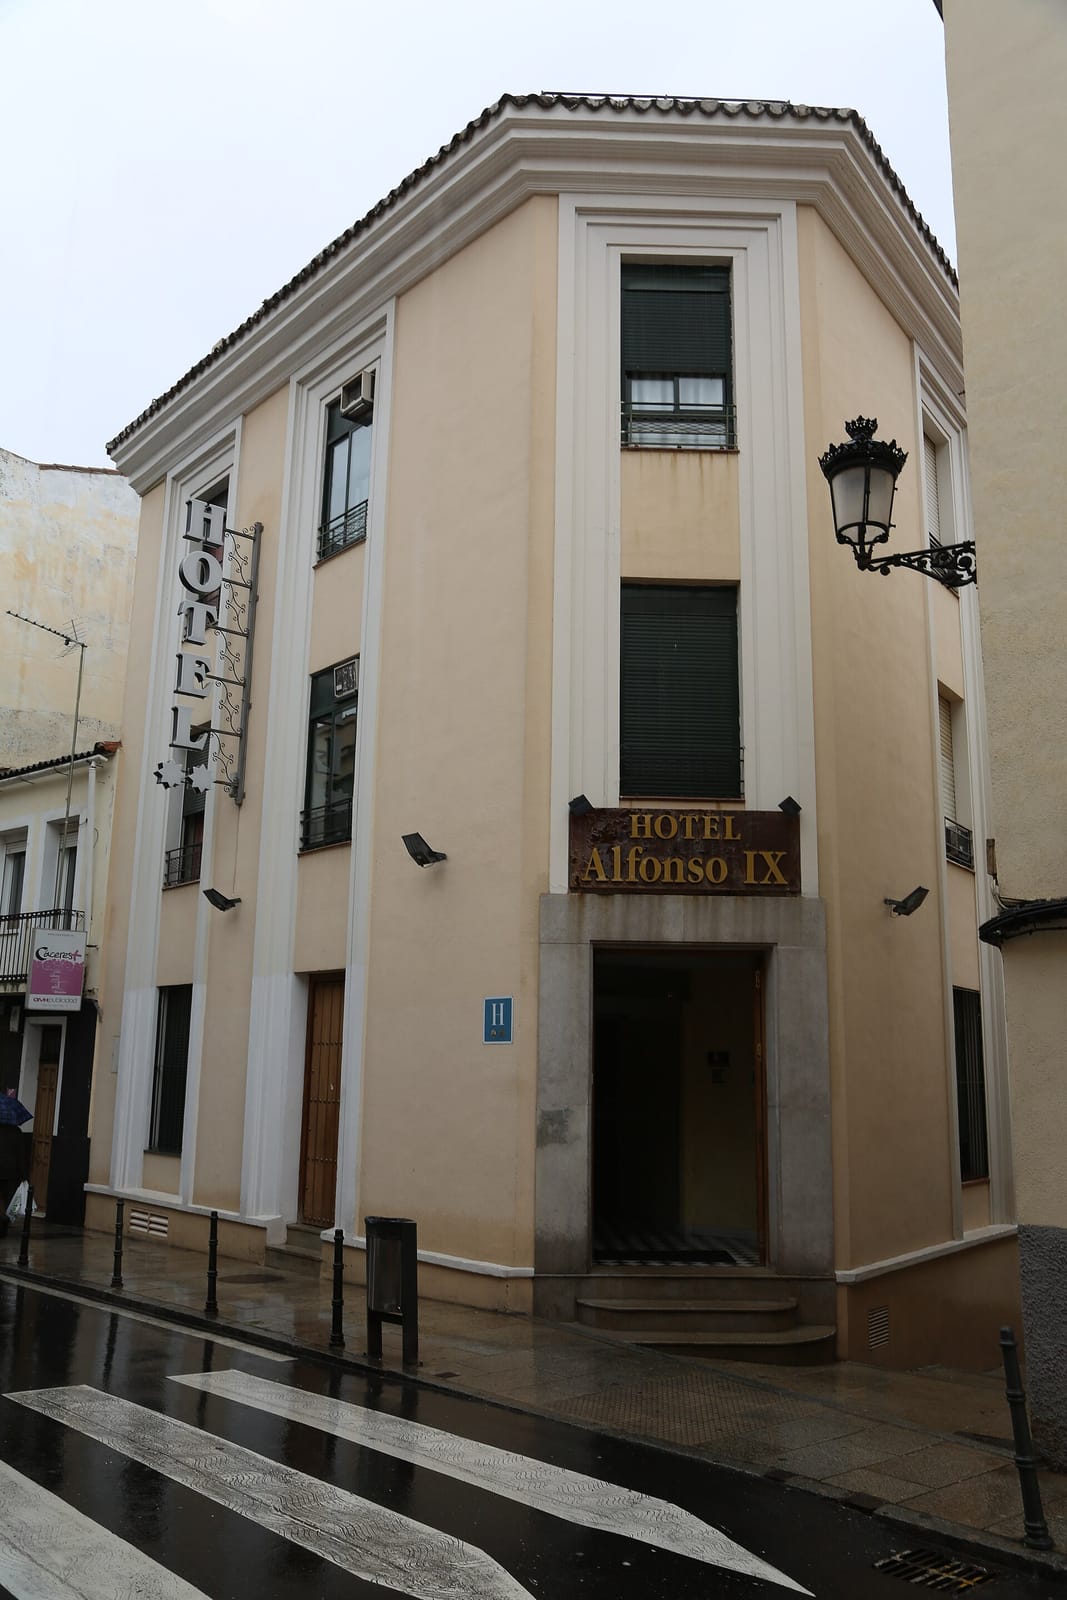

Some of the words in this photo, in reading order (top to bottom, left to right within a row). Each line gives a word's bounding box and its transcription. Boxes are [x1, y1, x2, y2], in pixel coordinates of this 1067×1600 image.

[169, 498, 227, 751] HOTEL
[629, 814, 742, 841] HOTEL
[581, 846, 729, 884] Alfonso
[743, 851, 788, 885] IX
[492, 1003, 505, 1025] H
